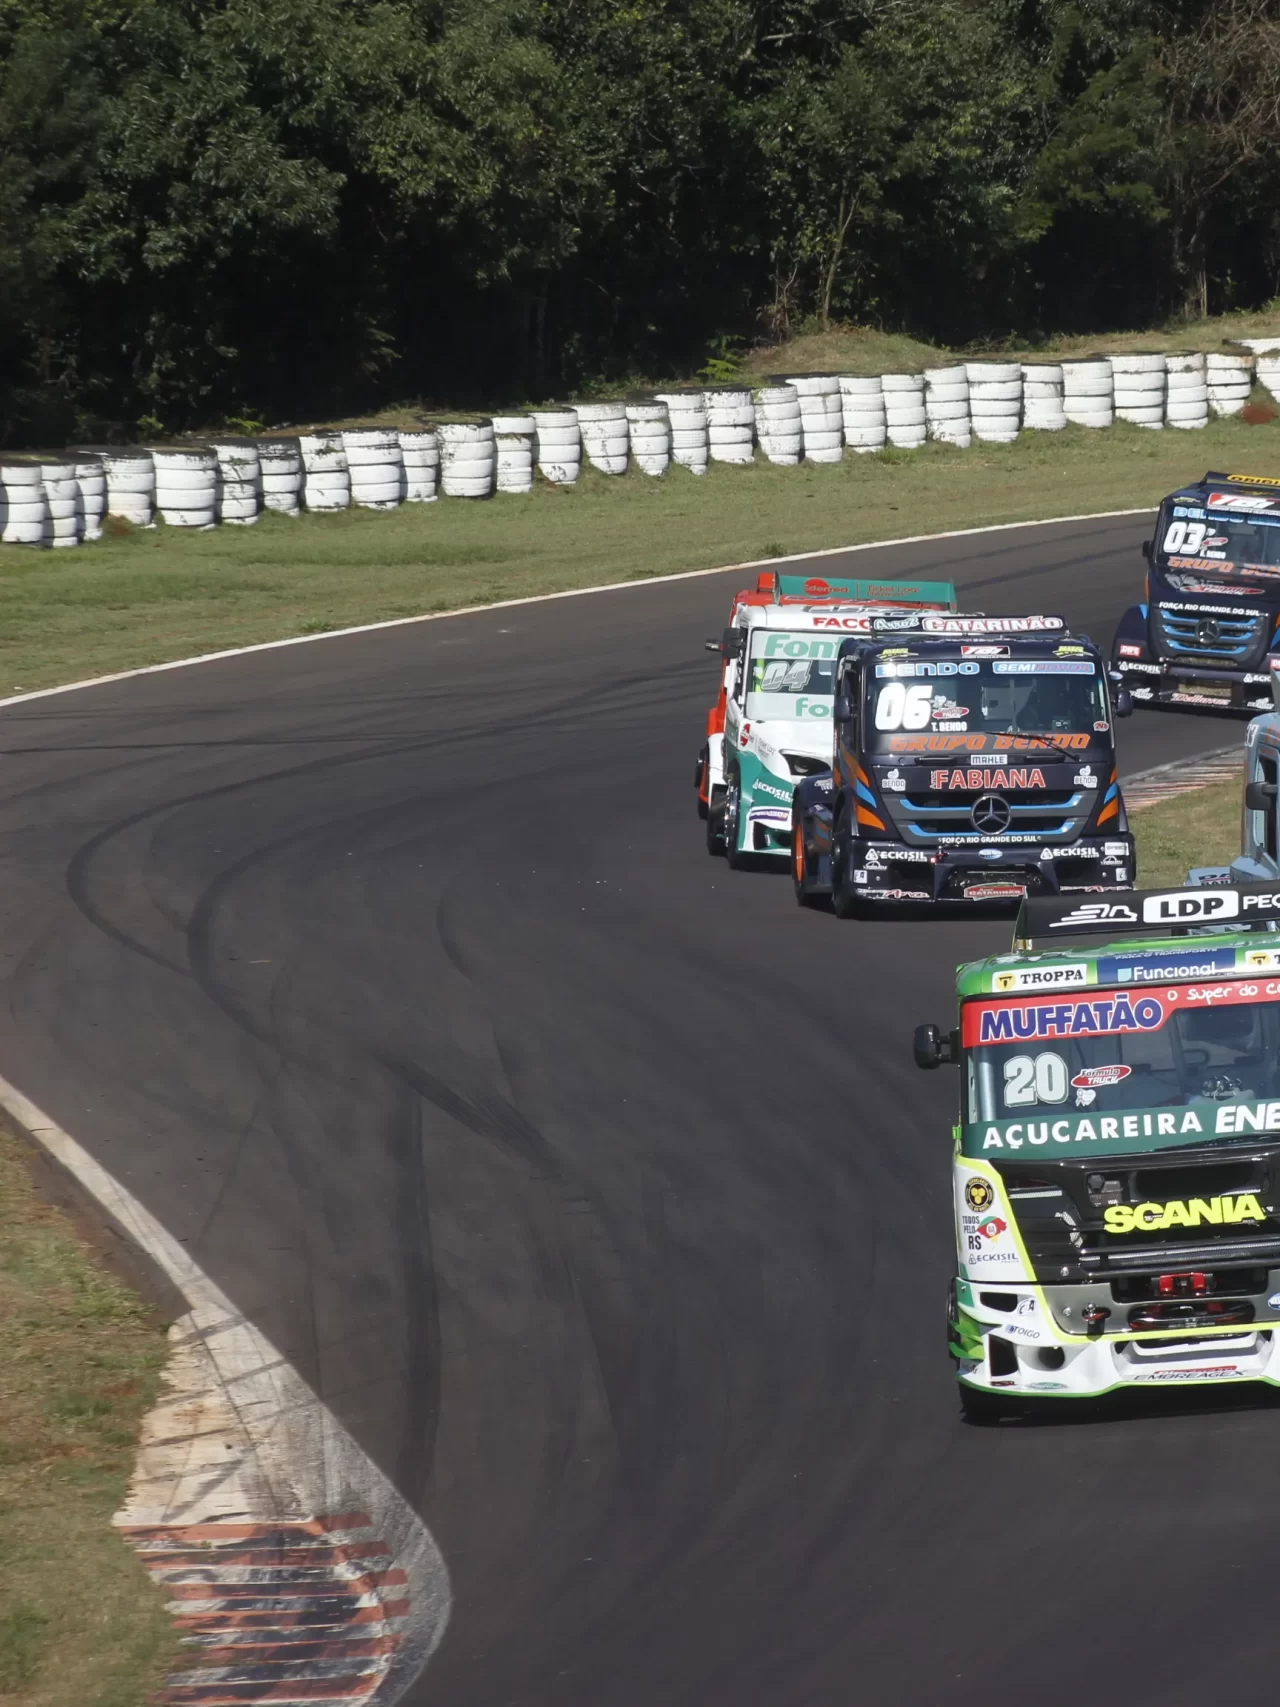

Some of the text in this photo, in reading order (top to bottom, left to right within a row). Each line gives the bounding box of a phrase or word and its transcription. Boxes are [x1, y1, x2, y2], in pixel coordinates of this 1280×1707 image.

[1163, 521, 1206, 554] 03
[1167, 556, 1235, 573] GRUPO
[1159, 601, 1183, 610] FORÇA
[1185, 603, 1198, 611] RIO
[1199, 605, 1231, 614] GRANDE
[922, 615, 1063, 632] CATARINÃO
[760, 660, 813, 692] 04
[875, 662, 980, 678] BENDO
[796, 697, 834, 717] fo
[875, 682, 933, 730] 06
[890, 735, 986, 751] GRUPO
[972, 756, 1005, 764] MAHLE
[935, 768, 1047, 789] FABIANA
[880, 851, 926, 860] ECKISIL
[1053, 847, 1099, 857] ECKISIL
[1160, 897, 1224, 918] LDP
[1020, 970, 1083, 985] TROPPA
[1133, 961, 1216, 981] Funcional
[1239, 984, 1258, 996] do
[980, 992, 1163, 1042] MUFFATÃO
[1004, 1052, 1068, 1108] 20
[1087, 1076, 1119, 1085] TRUCK
[983, 1111, 1202, 1149] AÇUCAREIRA
[962, 1216, 980, 1224] TODOS
[1104, 1194, 1267, 1234] SCANIA
[968, 1235, 982, 1250] RS
[977, 1253, 1018, 1262] ECKISIL
[1013, 1325, 1040, 1339] TOIGO
[1133, 1369, 1247, 1380] EMBREAGEX
